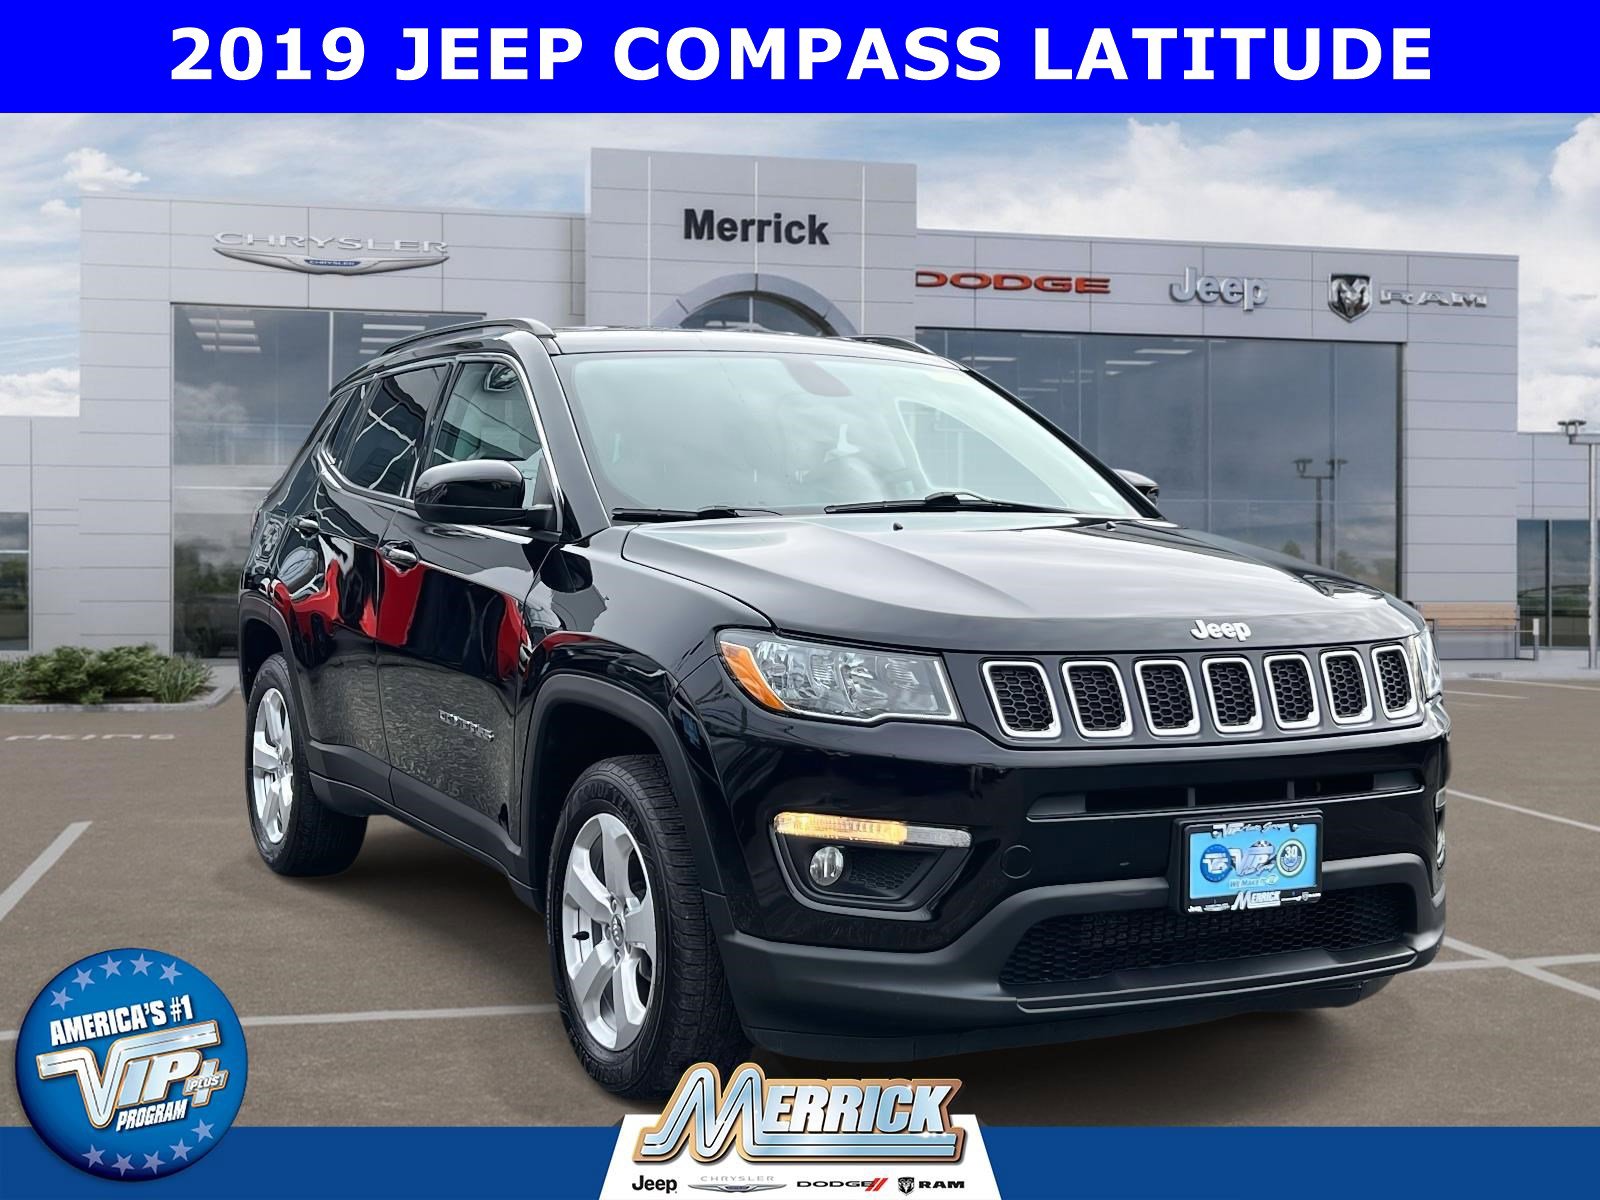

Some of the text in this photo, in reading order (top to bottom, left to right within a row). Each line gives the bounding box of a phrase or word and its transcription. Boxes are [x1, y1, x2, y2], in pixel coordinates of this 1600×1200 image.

[684, 208, 830, 245] Merrick
[214, 232, 449, 253] CHRYSLER
[915, 271, 1111, 294] DODGE
[1170, 267, 1269, 311] Jeep
[1380, 290, 1487, 307] RAM
[1190, 619, 1252, 642] Jeep
[1284, 845, 1298, 858] 30
[1231, 890, 1281, 910] MERRICK
